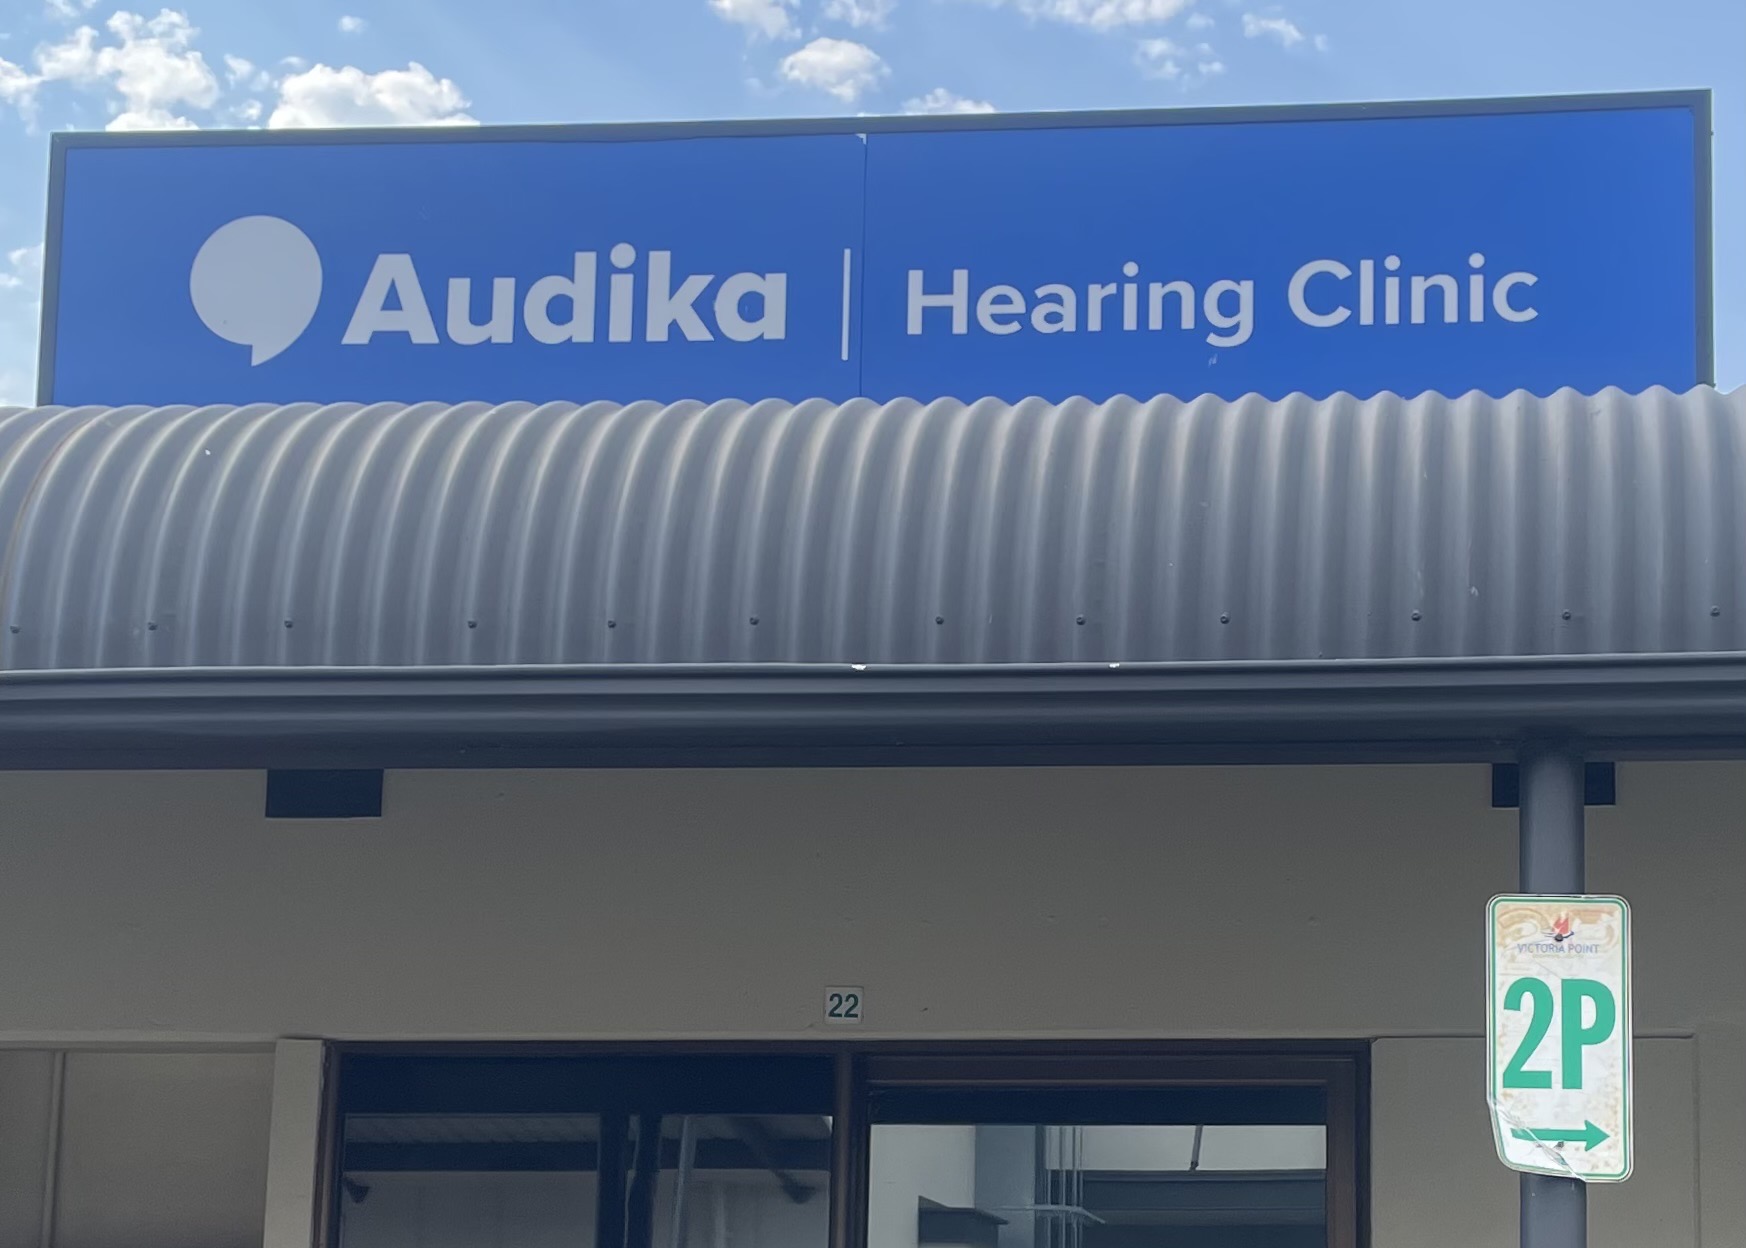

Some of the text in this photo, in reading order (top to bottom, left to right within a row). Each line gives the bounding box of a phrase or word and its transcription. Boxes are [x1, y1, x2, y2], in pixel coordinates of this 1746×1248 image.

[342, 243, 787, 346] Audika
[905, 253, 1540, 348] Hearing Clinic
[1516, 943, 1600, 954] VICTORIA POINT
[828, 993, 859, 1018] 22
[1502, 976, 1616, 1090] 2P
